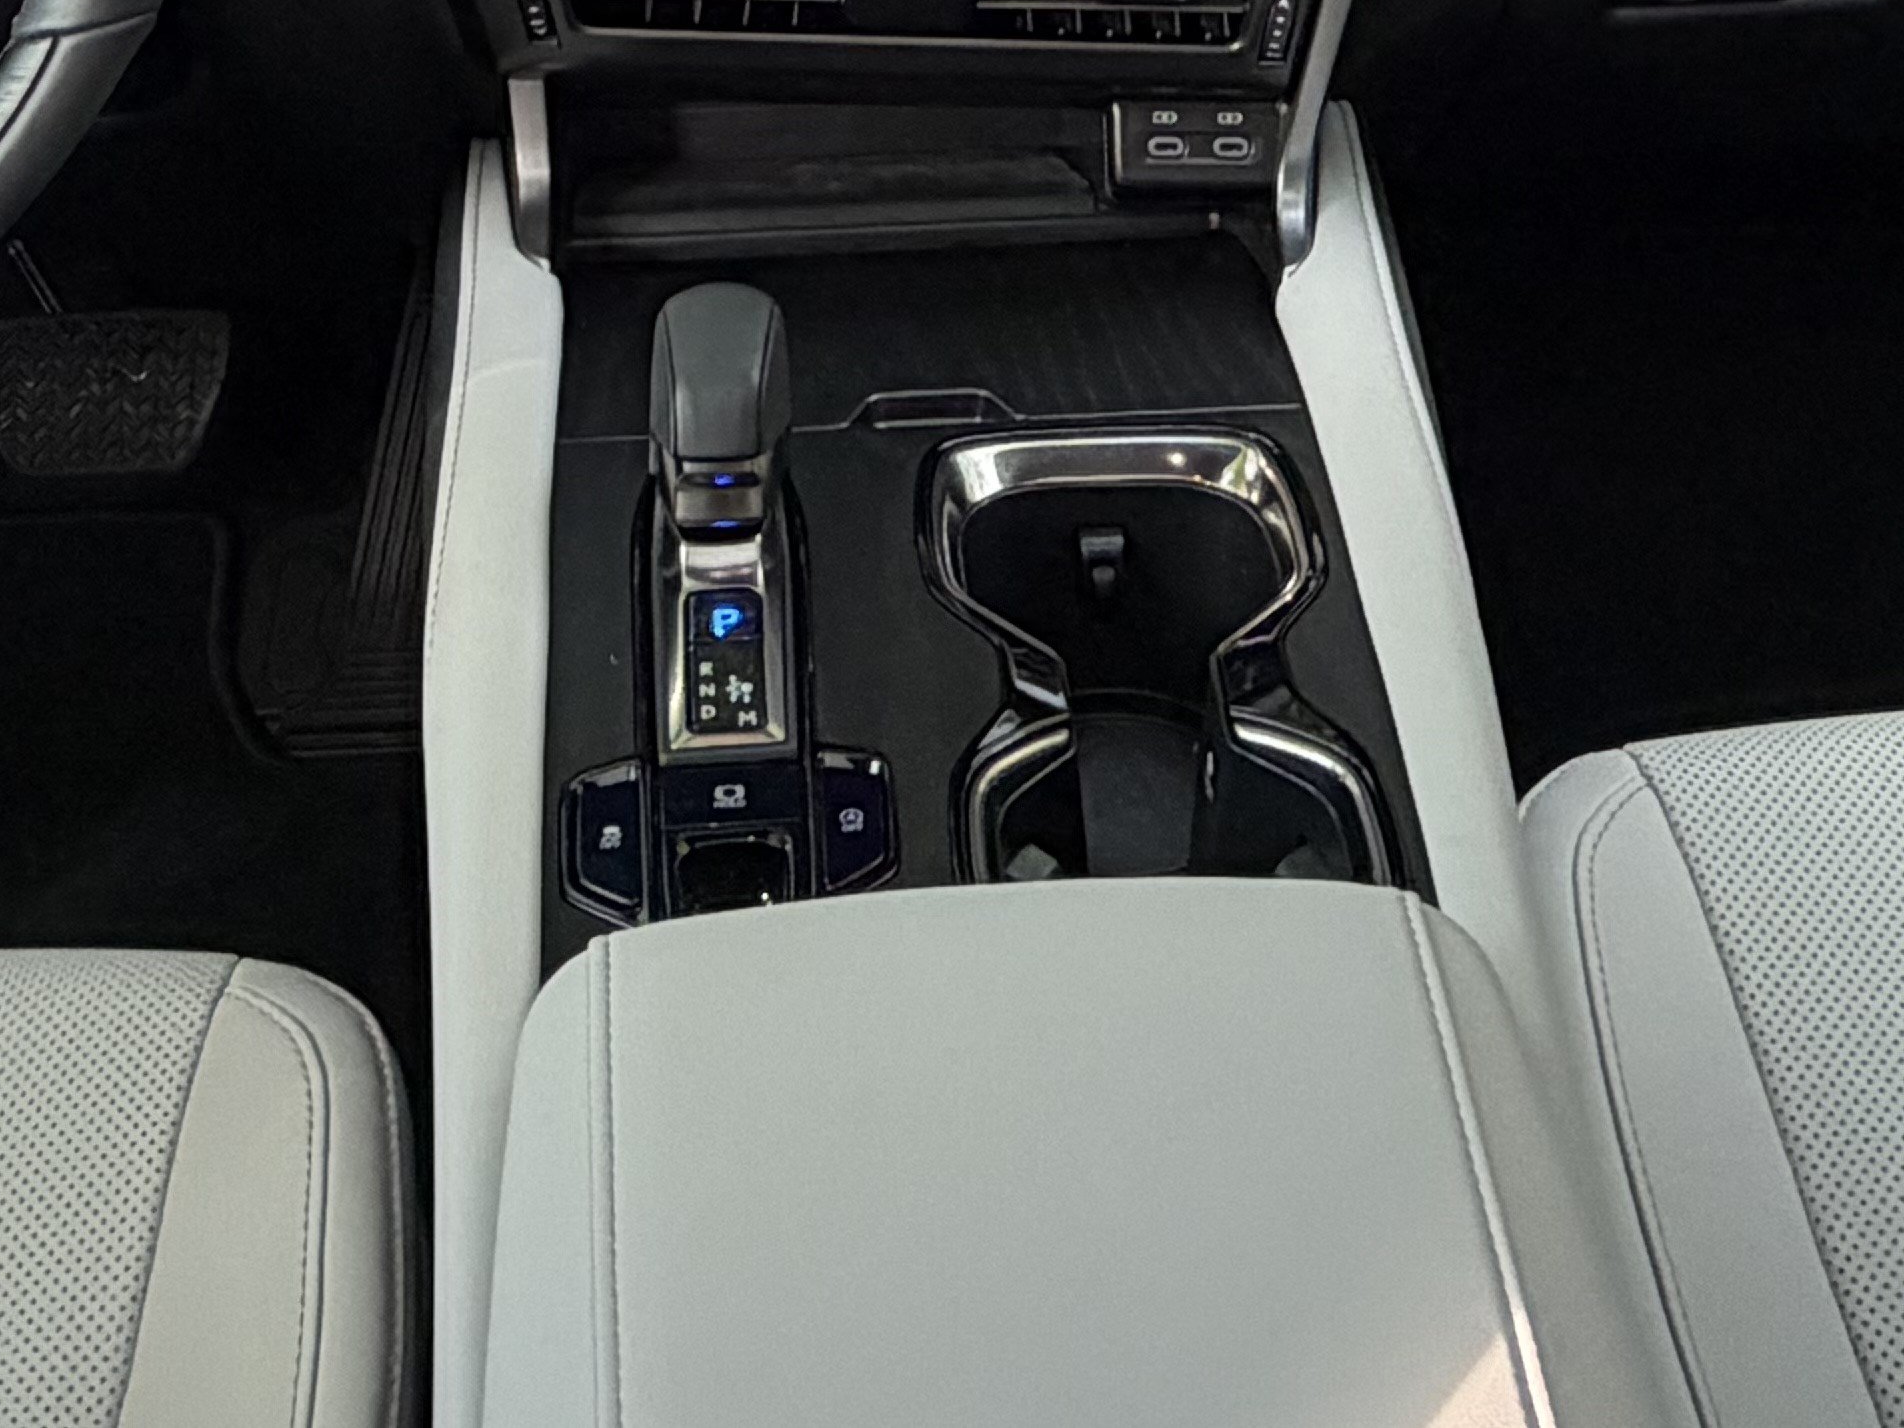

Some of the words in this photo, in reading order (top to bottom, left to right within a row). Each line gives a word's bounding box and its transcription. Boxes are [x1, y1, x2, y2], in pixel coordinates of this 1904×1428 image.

[711, 607, 741, 638] P
[698, 682, 716, 698] N
[700, 704, 717, 721] D
[737, 710, 758, 728] M
